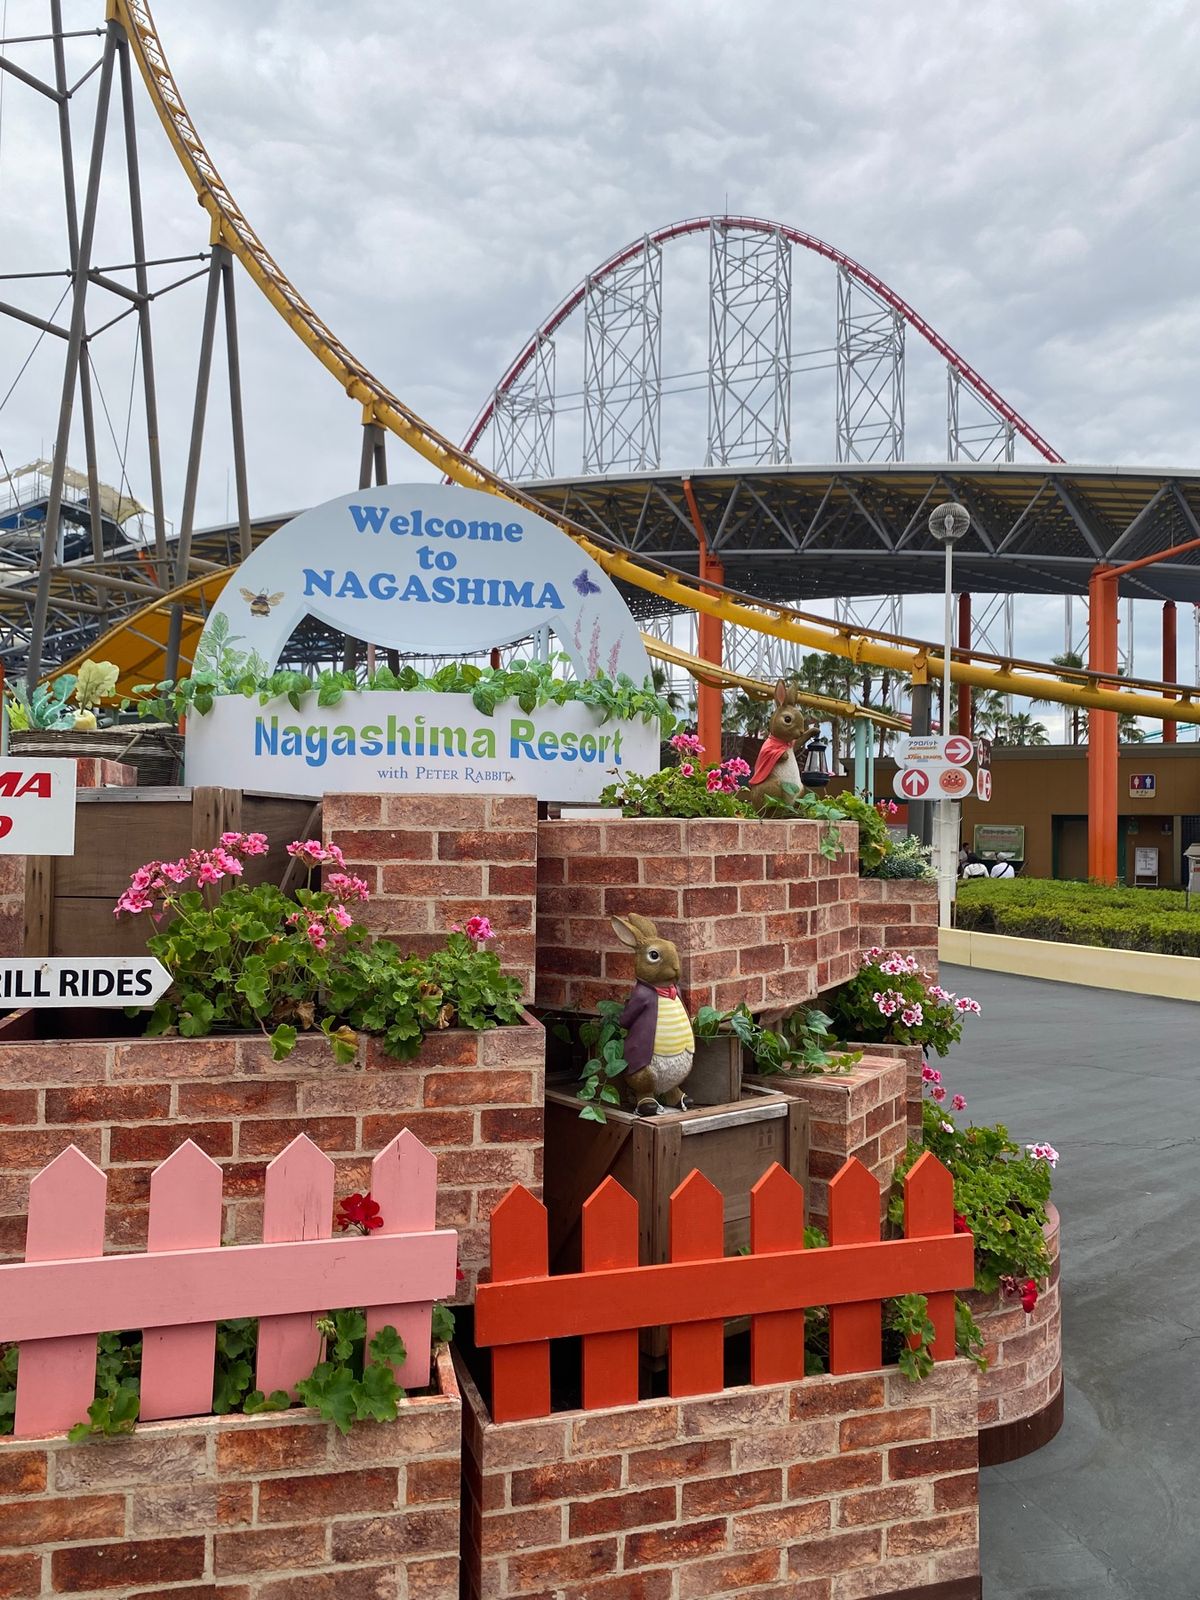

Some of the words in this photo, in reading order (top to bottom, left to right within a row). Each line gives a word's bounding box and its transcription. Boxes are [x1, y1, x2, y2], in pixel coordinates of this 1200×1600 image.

[348, 505, 524, 543] Welcome
[416, 545, 458, 572] to
[303, 568, 566, 609] NAGASHIMA
[254, 714, 497, 767] Nagashima
[509, 718, 624, 766] Resort
[377, 767, 409, 779] with
[416, 766, 459, 780] PETER
[465, 767, 512, 783] RABBIT
[0, 969, 51, 998] ILL
[59, 968, 153, 998] RIDES
